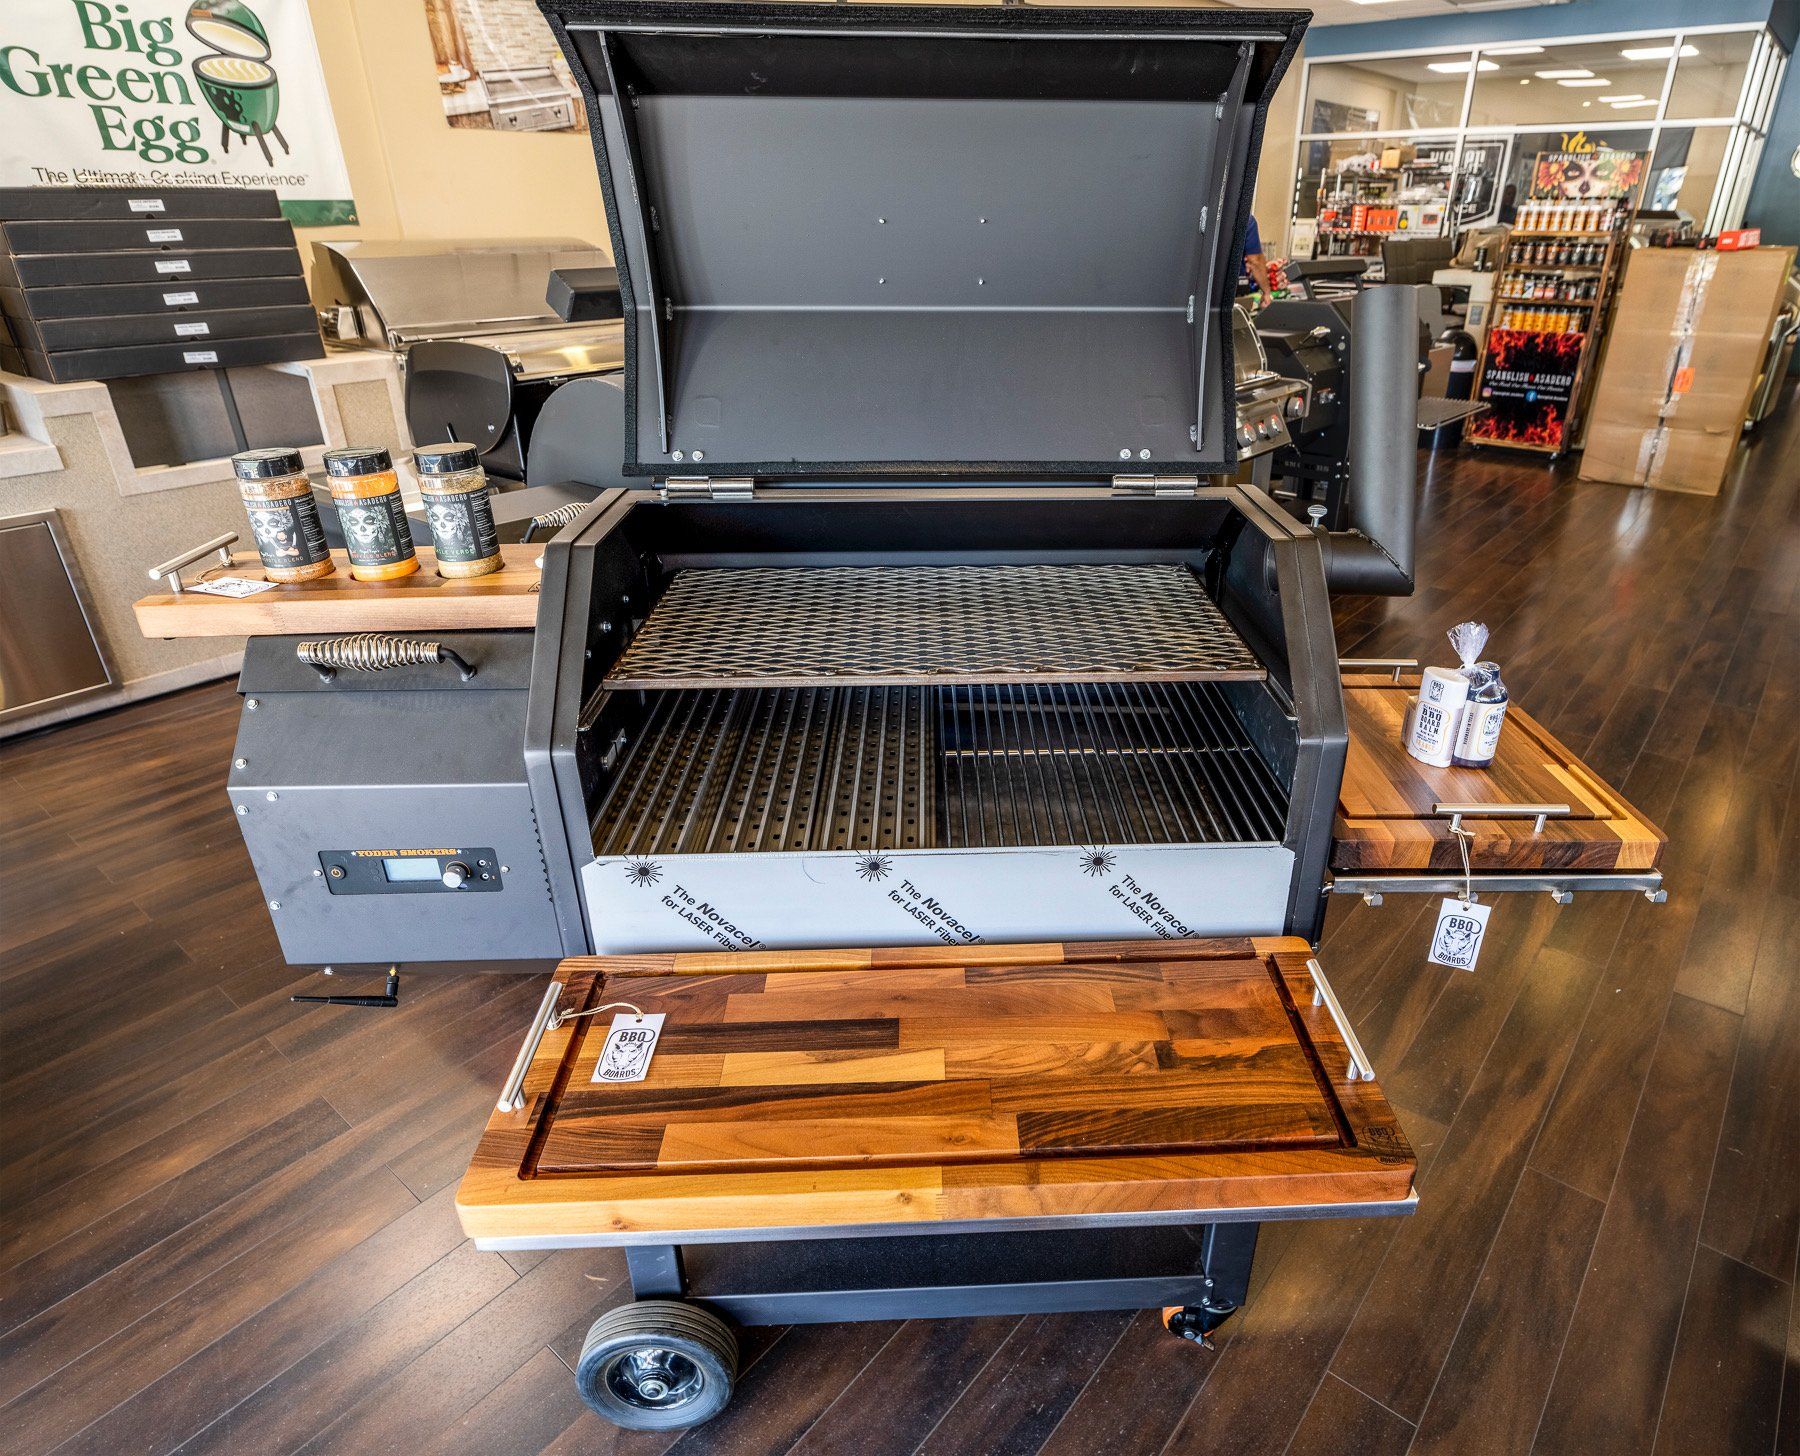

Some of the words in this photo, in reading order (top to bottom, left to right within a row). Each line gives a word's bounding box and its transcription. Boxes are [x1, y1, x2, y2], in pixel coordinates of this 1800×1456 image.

[72, 0, 183, 67] Big
[0, 46, 196, 106] Green
[88, 104, 210, 164] Egg
[31, 167, 68, 185] The
[221, 171, 305, 188] Experience
[1486, 369, 1530, 382] SPANGLISH
[1533, 372, 1572, 387] ASADERO
[263, 498, 292, 508] ASADERO
[359, 495, 387, 506] ASADERO
[440, 493, 468, 503] ASADERO
[1422, 708, 1442, 722] BBQ
[356, 849, 398, 857] YODER
[400, 848, 457, 856] SMOKERS
[900, 879, 922, 900] The
[1121, 874, 1142, 895] The
[673, 884, 696, 905] The
[887, 889, 905, 904] for
[903, 901, 936, 930] LASER
[1108, 884, 1126, 899] for
[1122, 896, 1153, 925] LASER
[661, 895, 680, 910] for
[678, 907, 714, 935] LASER
[1449, 917, 1474, 932] BBQ
[1437, 951, 1467, 965] BOARDS
[619, 1031, 647, 1043] BBQ
[602, 1068, 637, 1079] BOARDS
